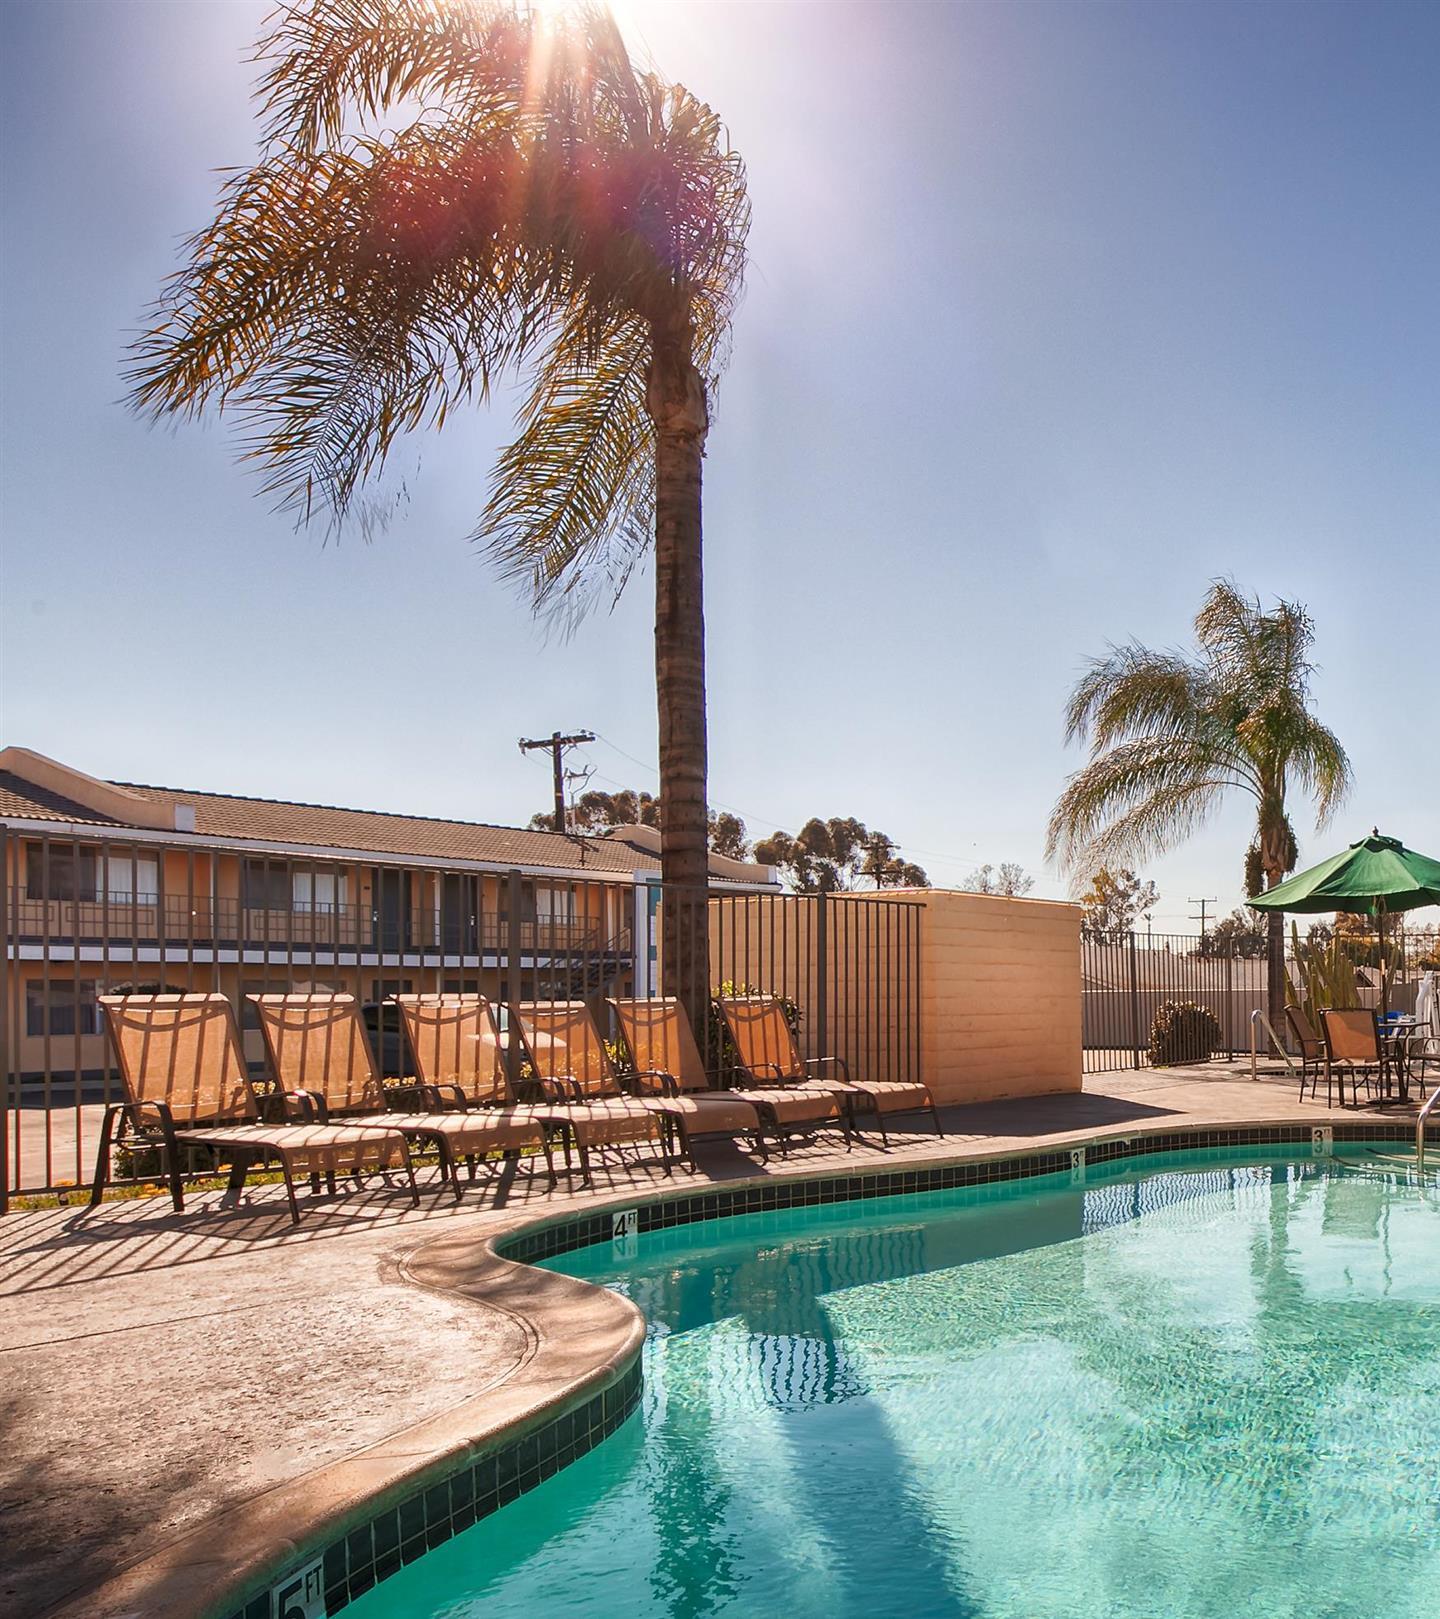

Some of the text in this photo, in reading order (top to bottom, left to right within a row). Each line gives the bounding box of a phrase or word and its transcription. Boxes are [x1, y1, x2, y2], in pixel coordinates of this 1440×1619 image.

[1073, 1152, 1080, 1168] 3
[614, 1212, 637, 1237] 4 FT
[305, 1564, 322, 1603] FT
